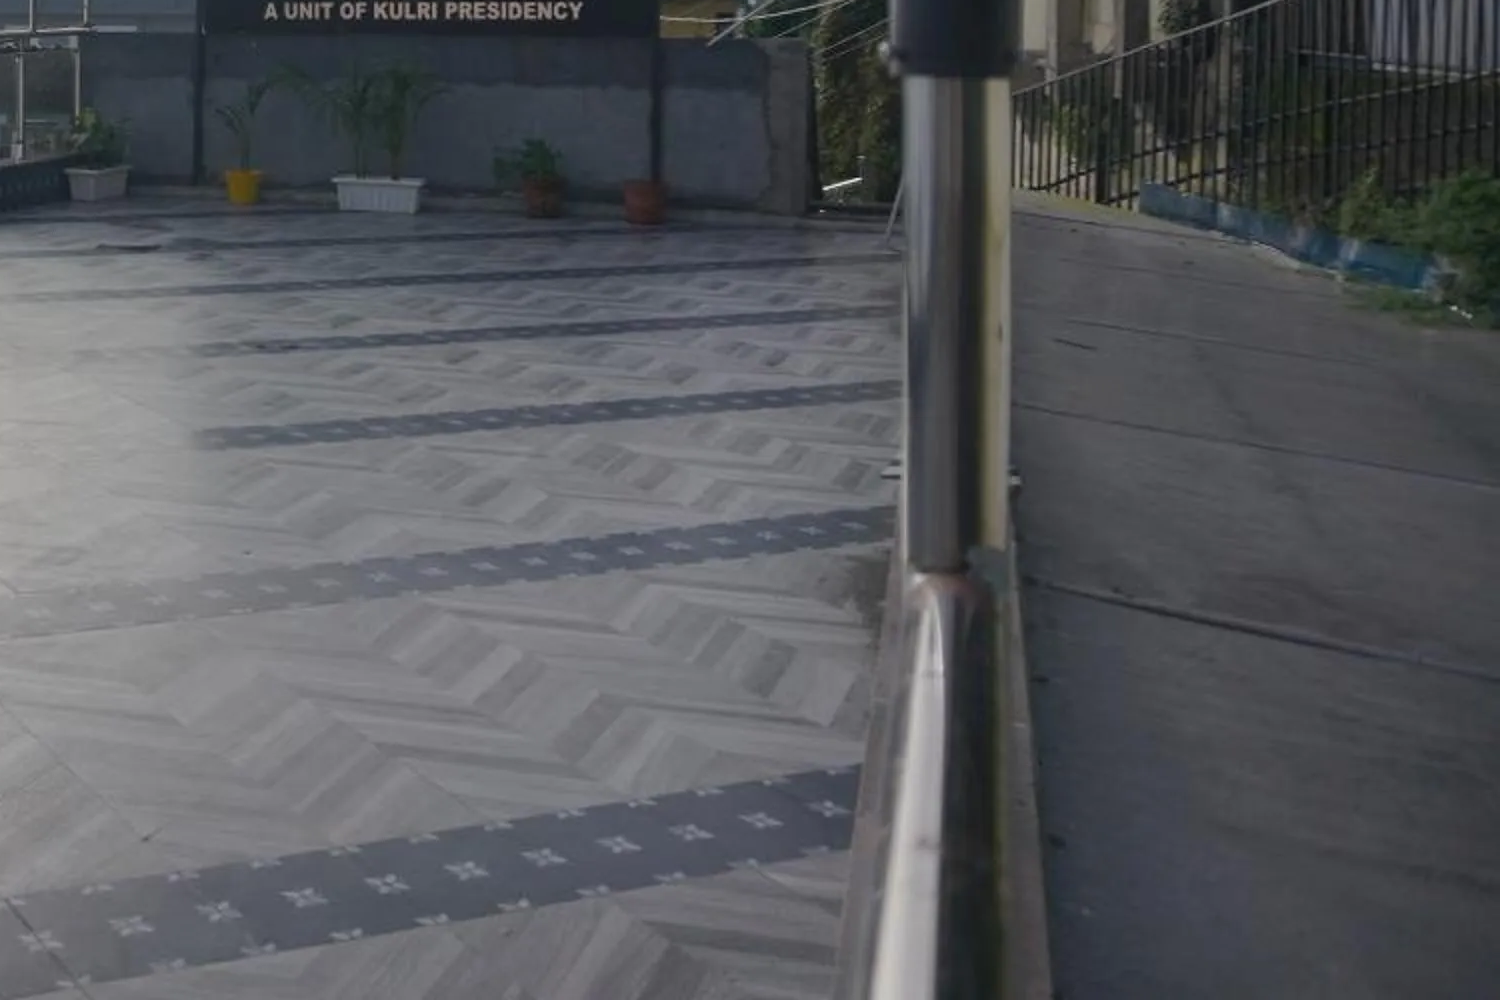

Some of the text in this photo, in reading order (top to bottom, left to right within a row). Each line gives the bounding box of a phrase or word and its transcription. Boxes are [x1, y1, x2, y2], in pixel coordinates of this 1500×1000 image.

[264, 1, 583, 20] A UNIT OF KULRI PRESIDENCY
